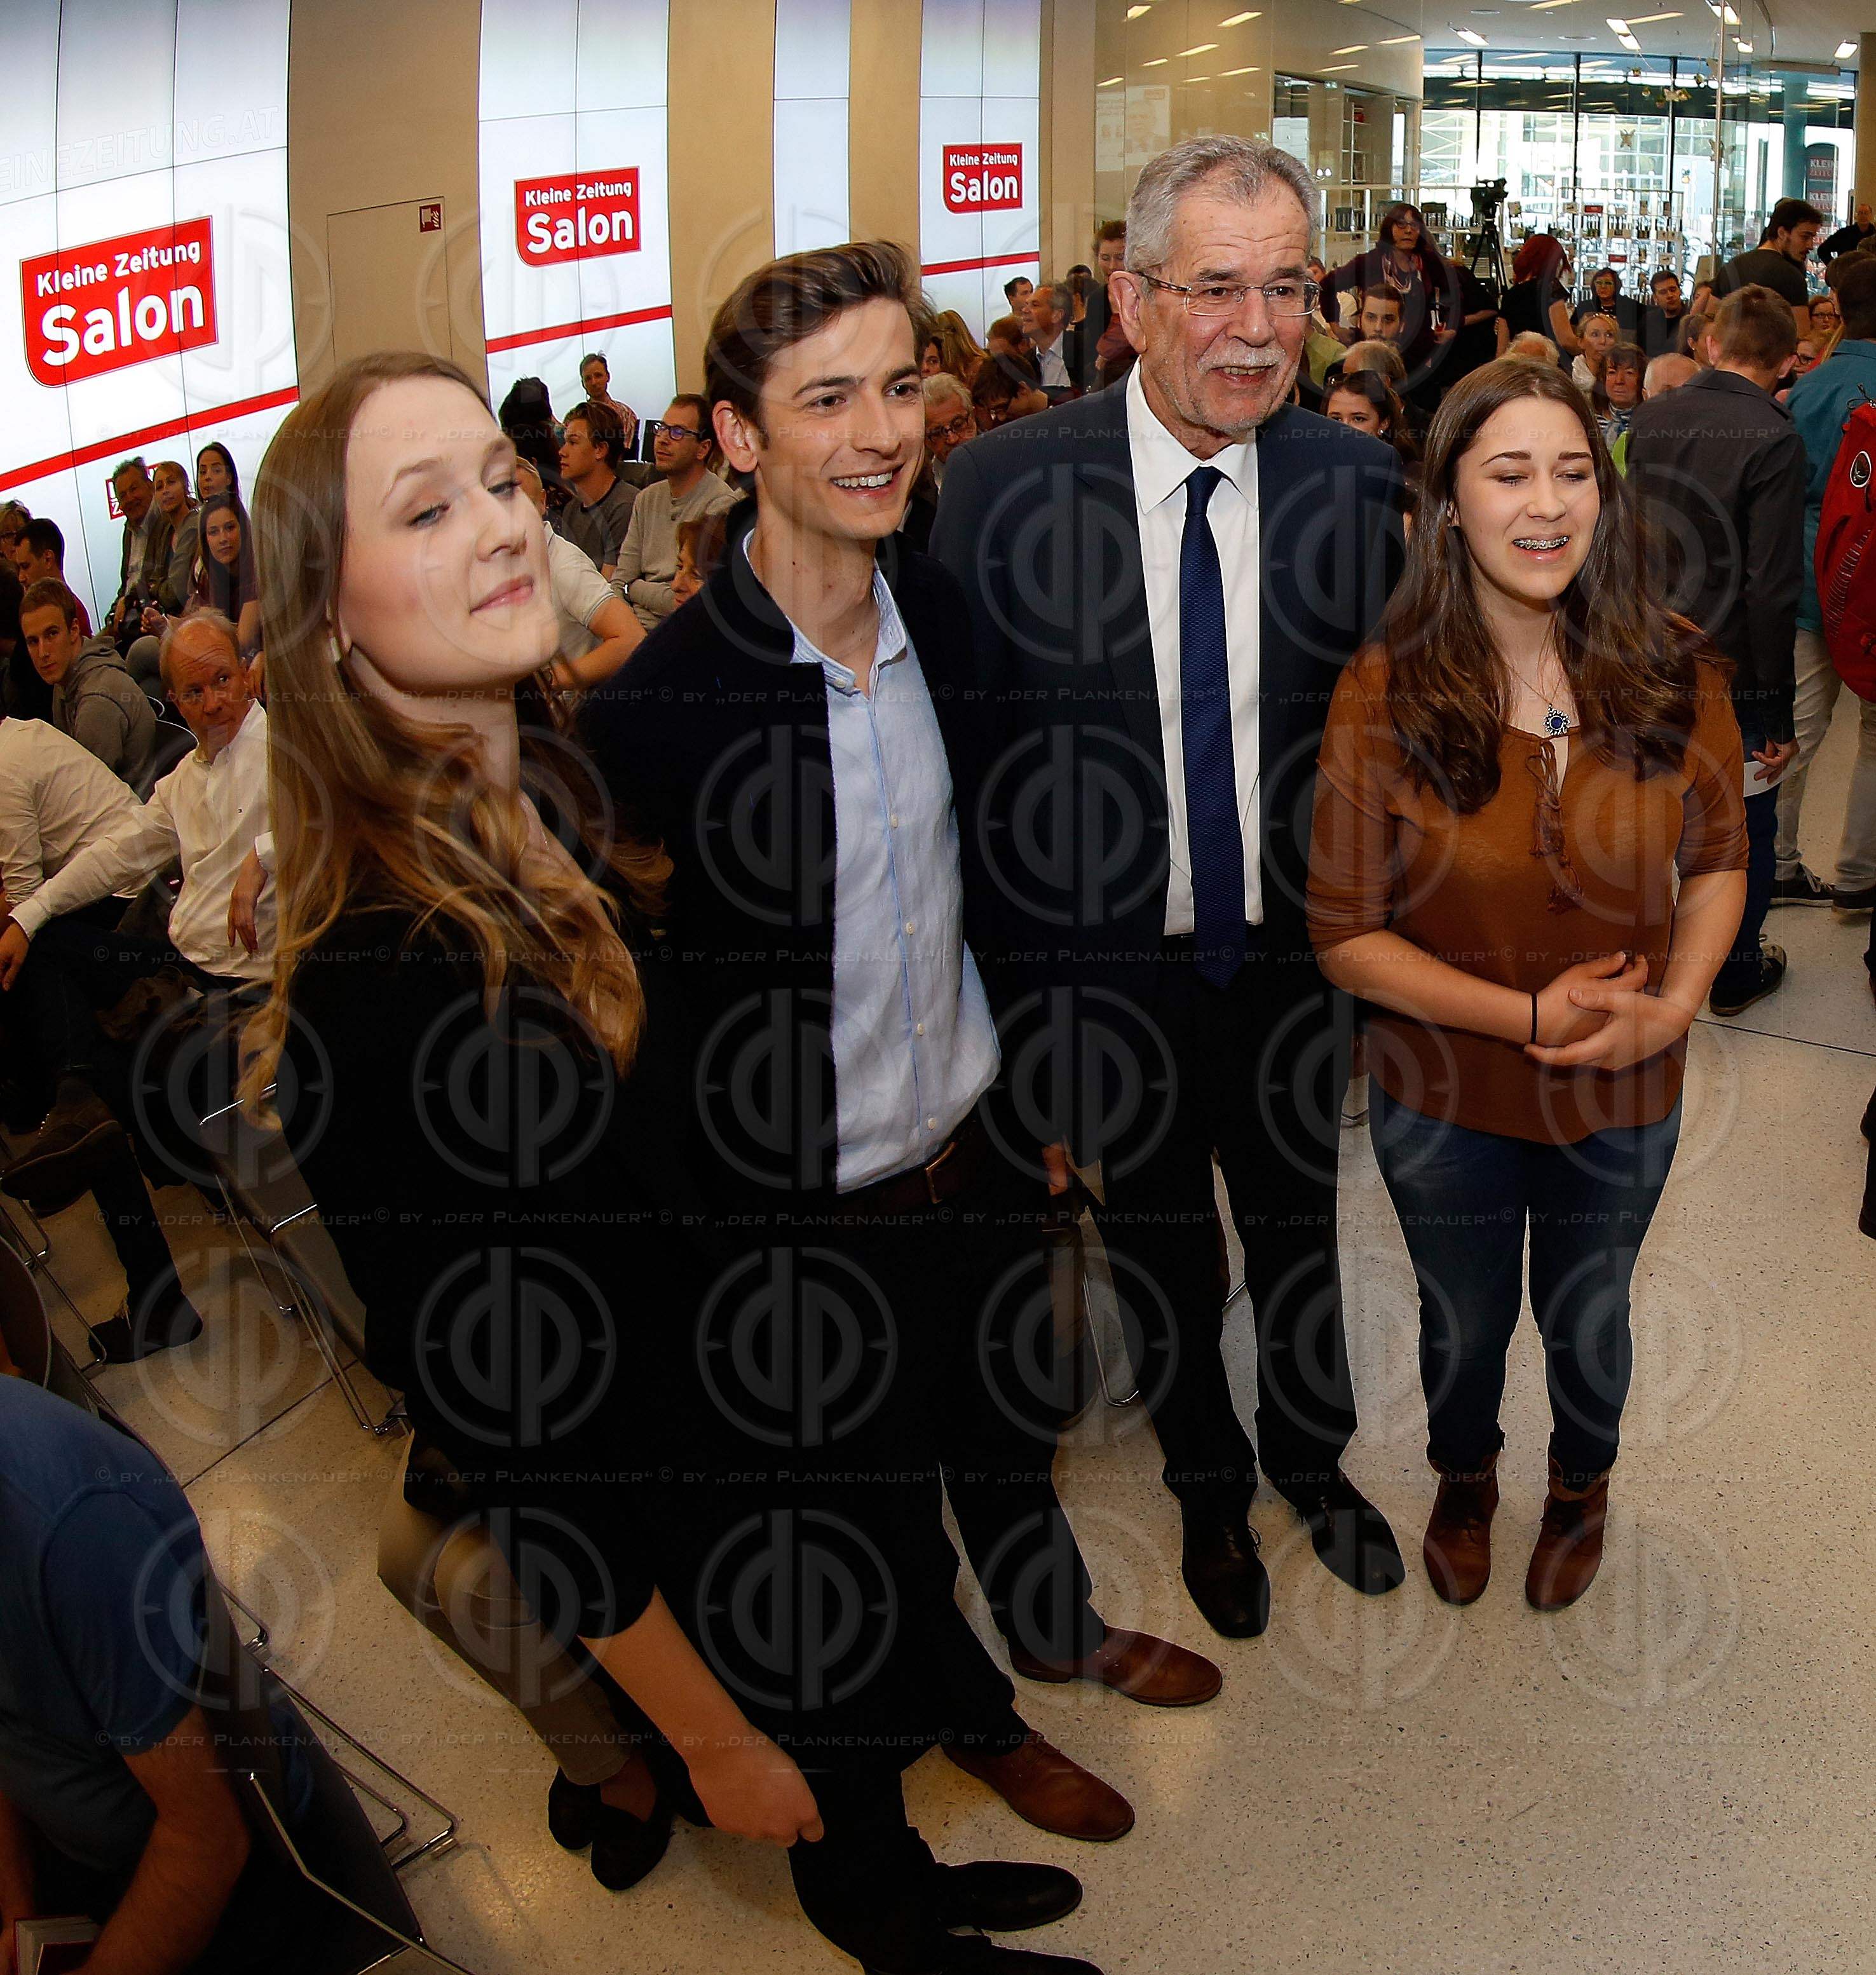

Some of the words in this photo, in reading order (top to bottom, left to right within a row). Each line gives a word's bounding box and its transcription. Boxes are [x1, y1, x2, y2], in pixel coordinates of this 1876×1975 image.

[949, 154, 980, 166] Kleine
[982, 153, 1017, 166] Zeitung
[525, 187, 571, 207] Kleine
[576, 181, 632, 201] Zeitung
[949, 170, 1018, 204] Salon
[526, 206, 633, 254] Salon
[37, 261, 107, 297] Kleine
[114, 239, 201, 278] Zeitung
[41, 283, 204, 367] Salon
